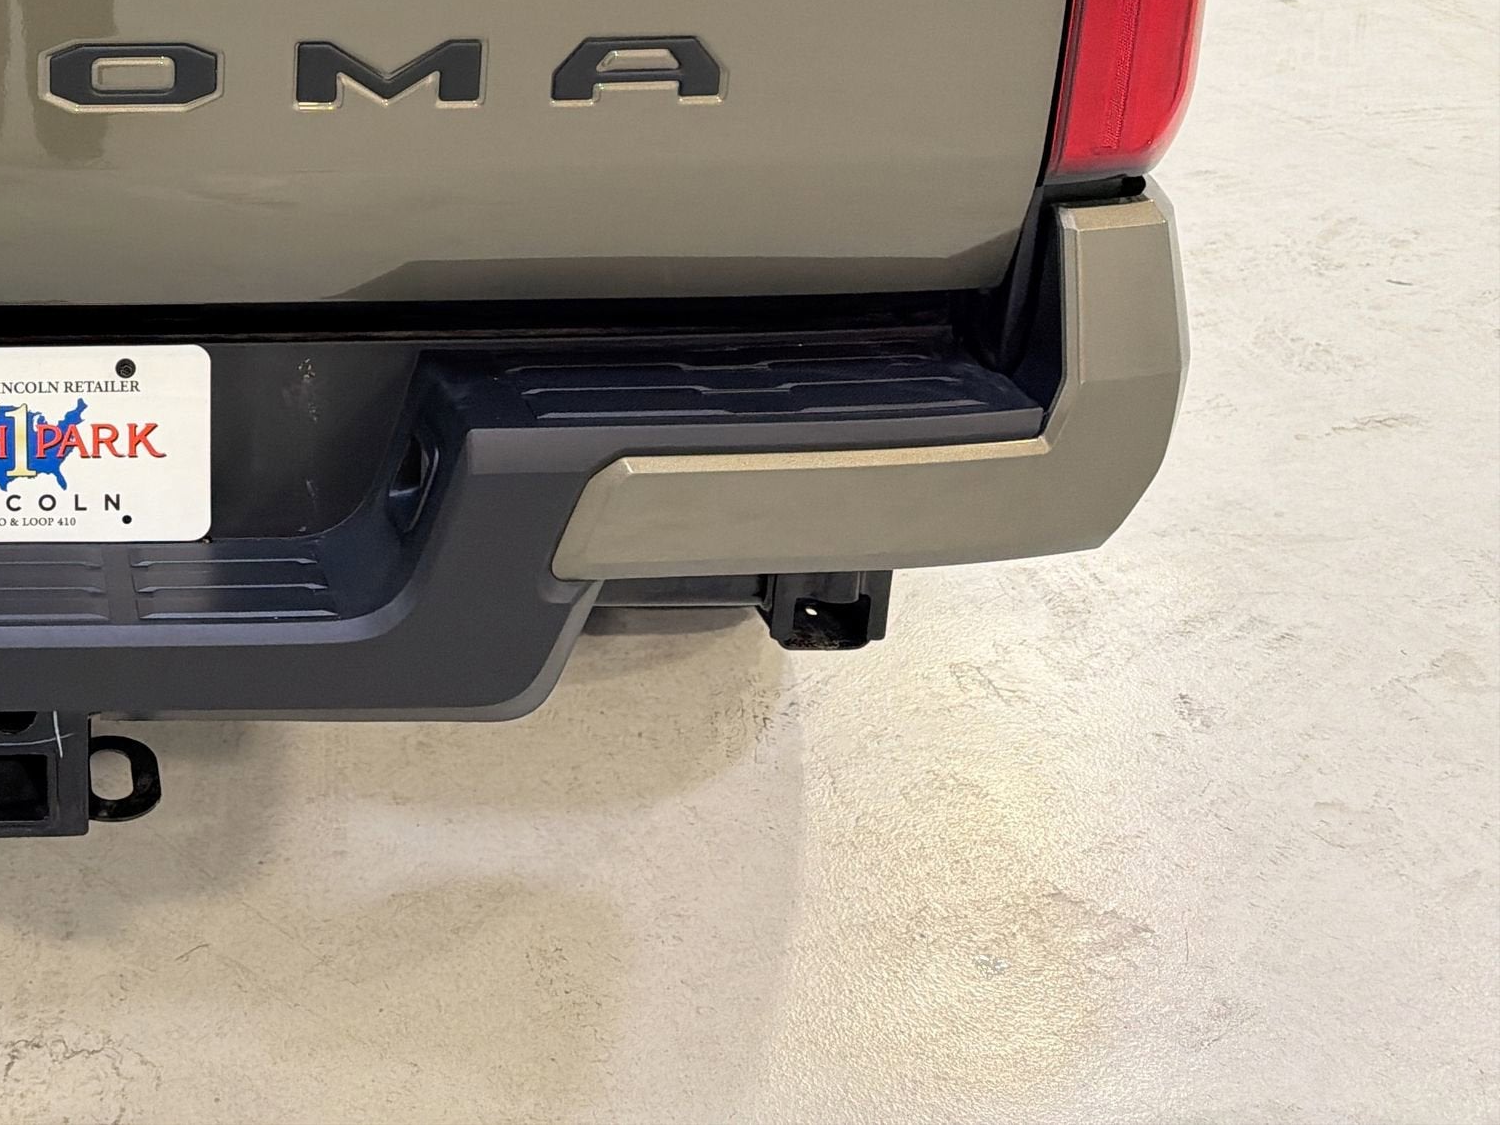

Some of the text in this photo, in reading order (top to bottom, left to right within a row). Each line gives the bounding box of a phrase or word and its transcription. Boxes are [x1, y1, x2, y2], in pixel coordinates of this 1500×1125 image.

[64, 380, 141, 393] RETAILER
[36, 422, 167, 459] PARK
[10, 518, 19, 526] &
[22, 517, 55, 526] LOOP
[57, 517, 77, 526] 410
